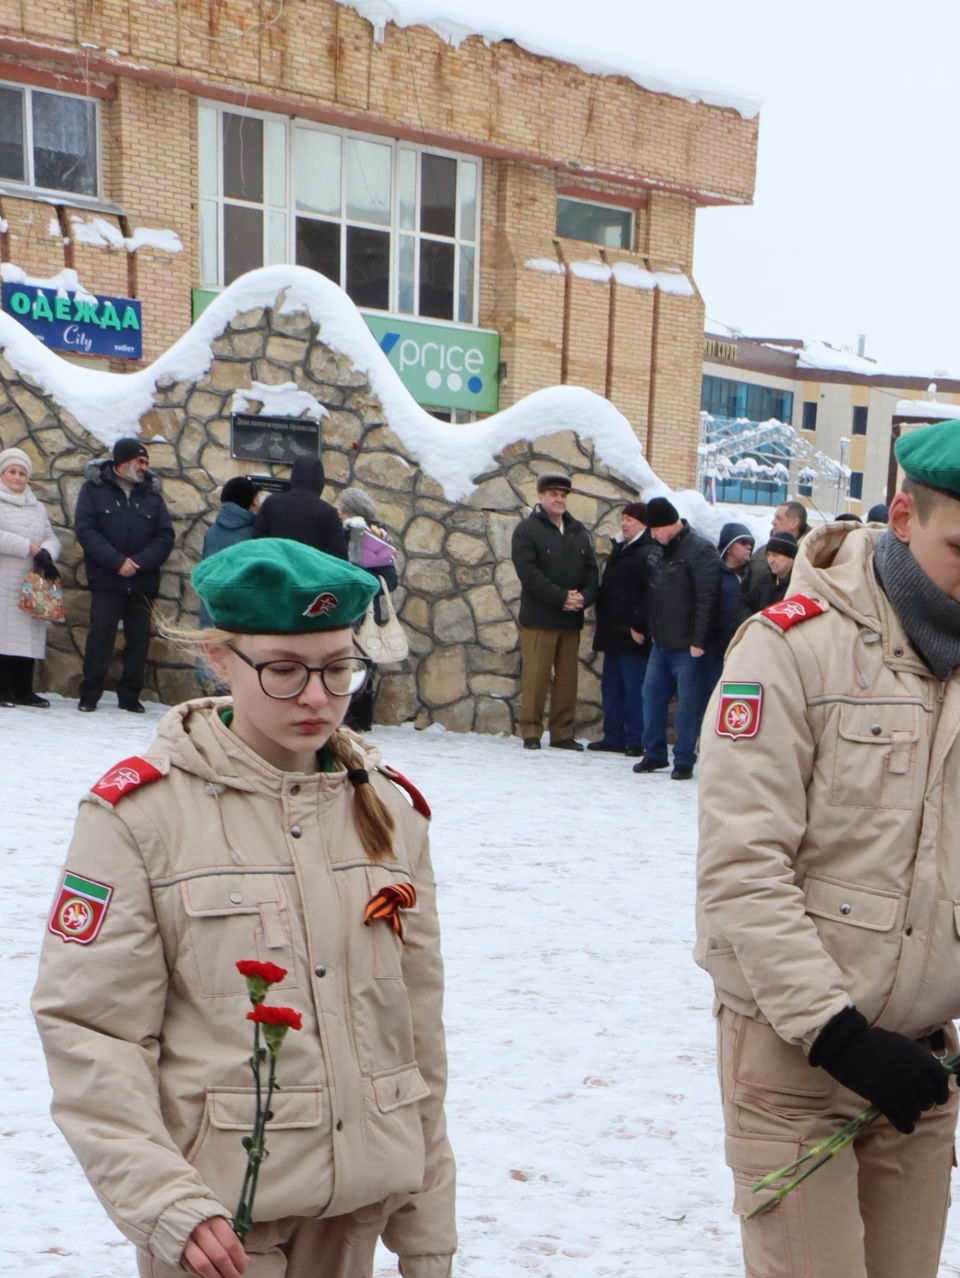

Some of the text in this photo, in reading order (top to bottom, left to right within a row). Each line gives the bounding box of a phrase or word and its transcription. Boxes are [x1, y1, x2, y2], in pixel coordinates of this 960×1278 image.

[10, 290, 140, 331] ОДЕЖДА
[63, 324, 93, 352] City
[399, 338, 484, 374] price
